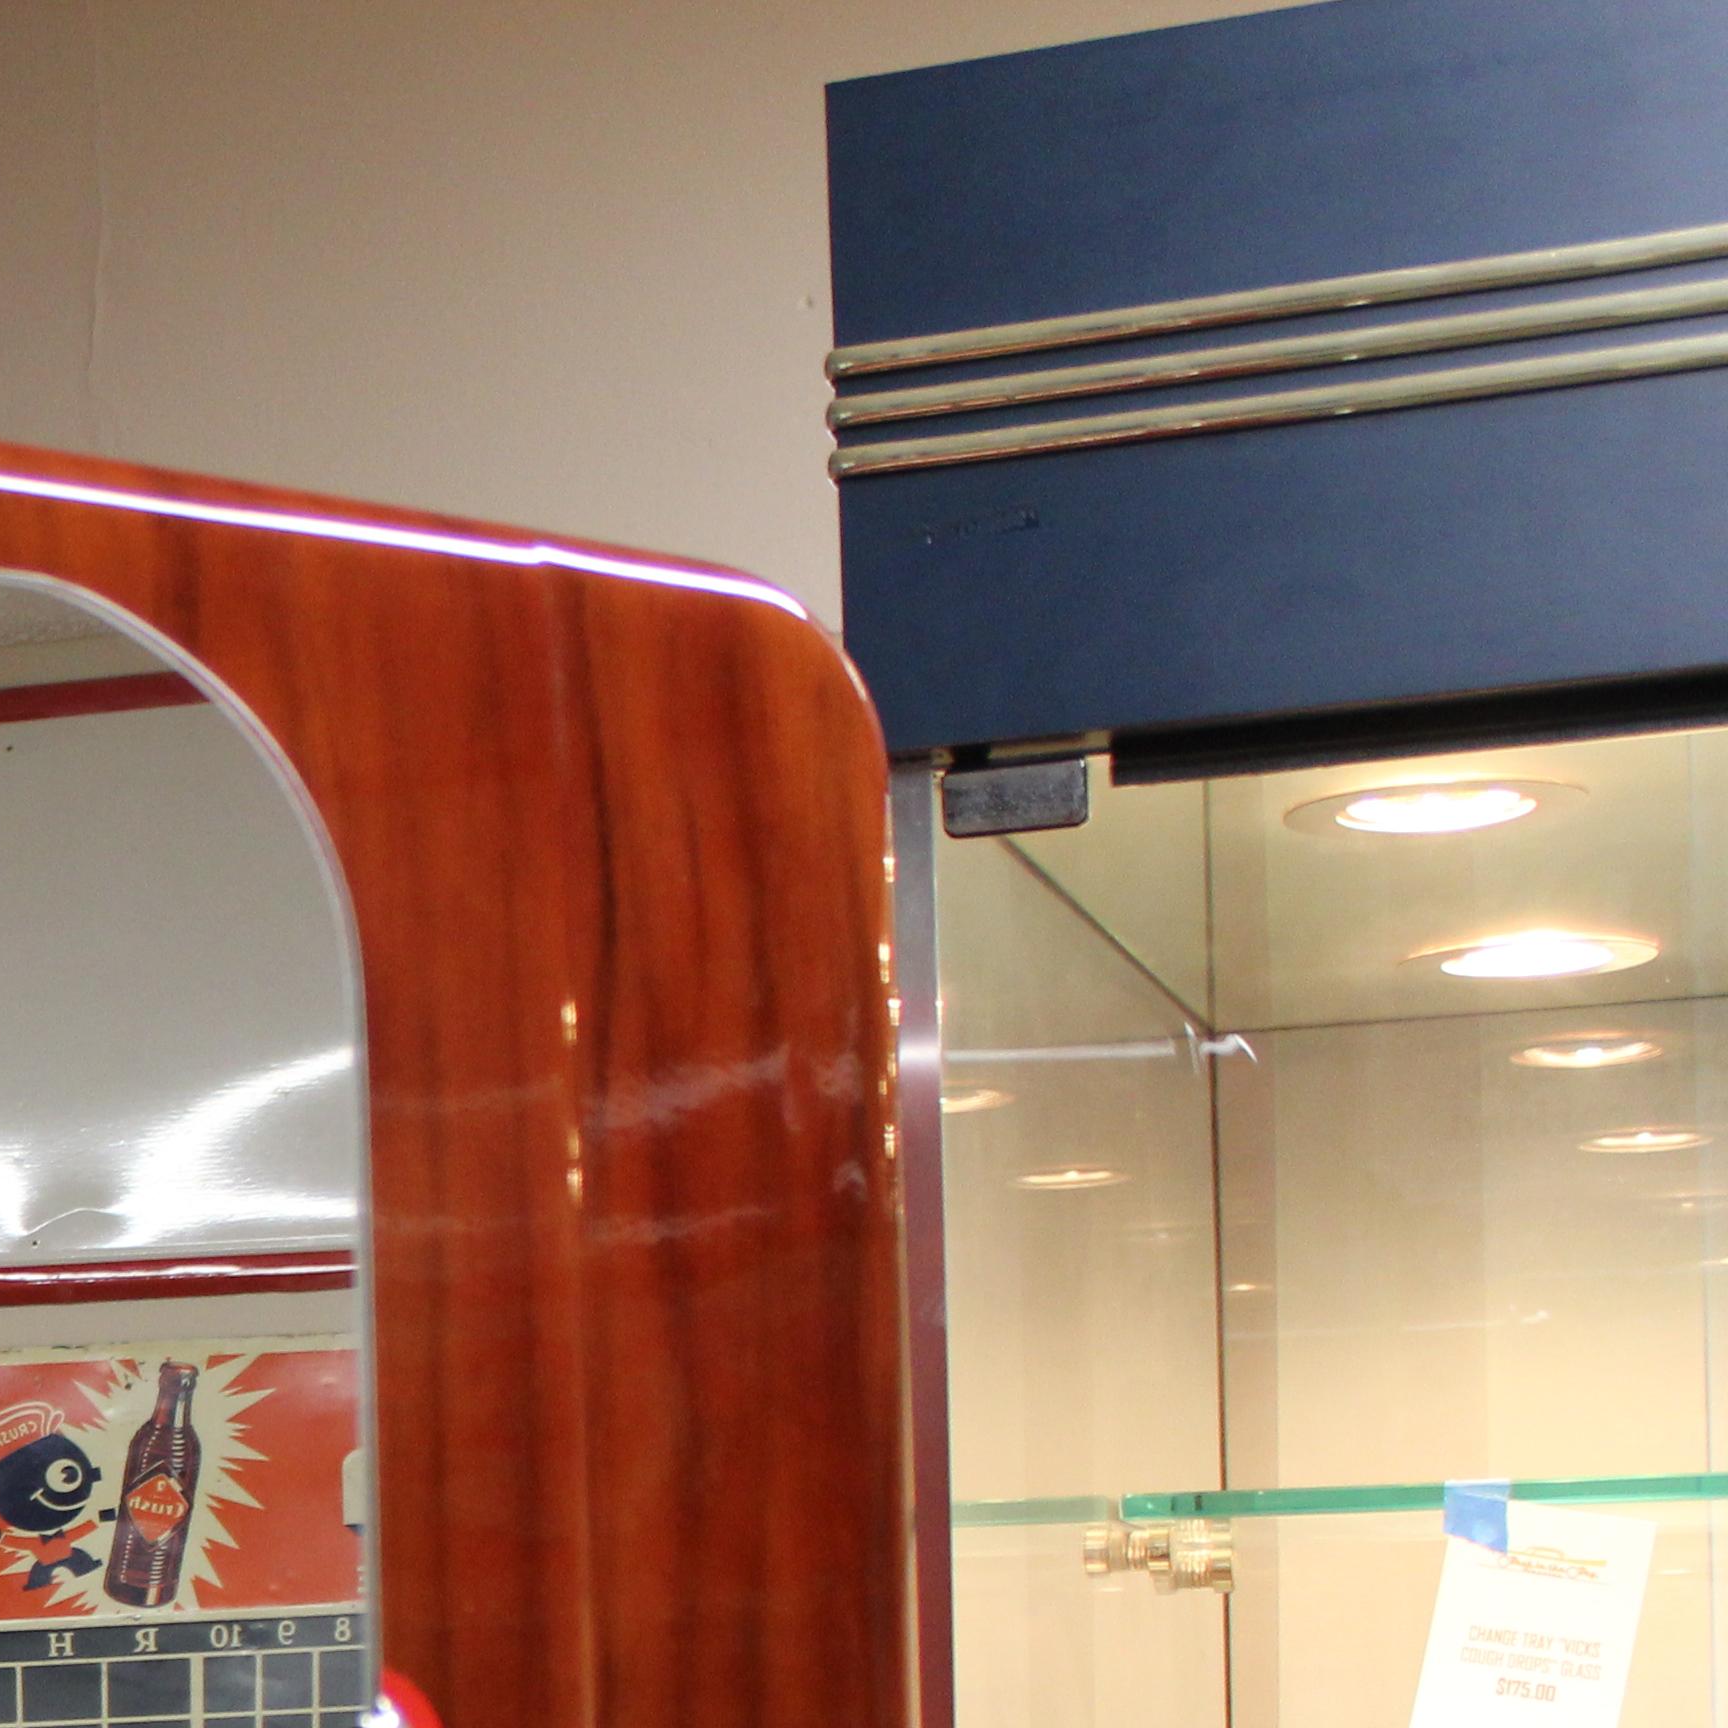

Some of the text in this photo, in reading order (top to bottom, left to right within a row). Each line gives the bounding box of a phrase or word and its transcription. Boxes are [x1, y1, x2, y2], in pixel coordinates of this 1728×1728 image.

[1469, 1625, 1517, 1647] CHANGE
[1523, 1632, 1553, 1650] TRAY
[1461, 1647, 1503, 1666] COUGH
[1561, 1661, 1601, 1680] GLASS
[1496, 1678, 1556, 1701] $175.00
